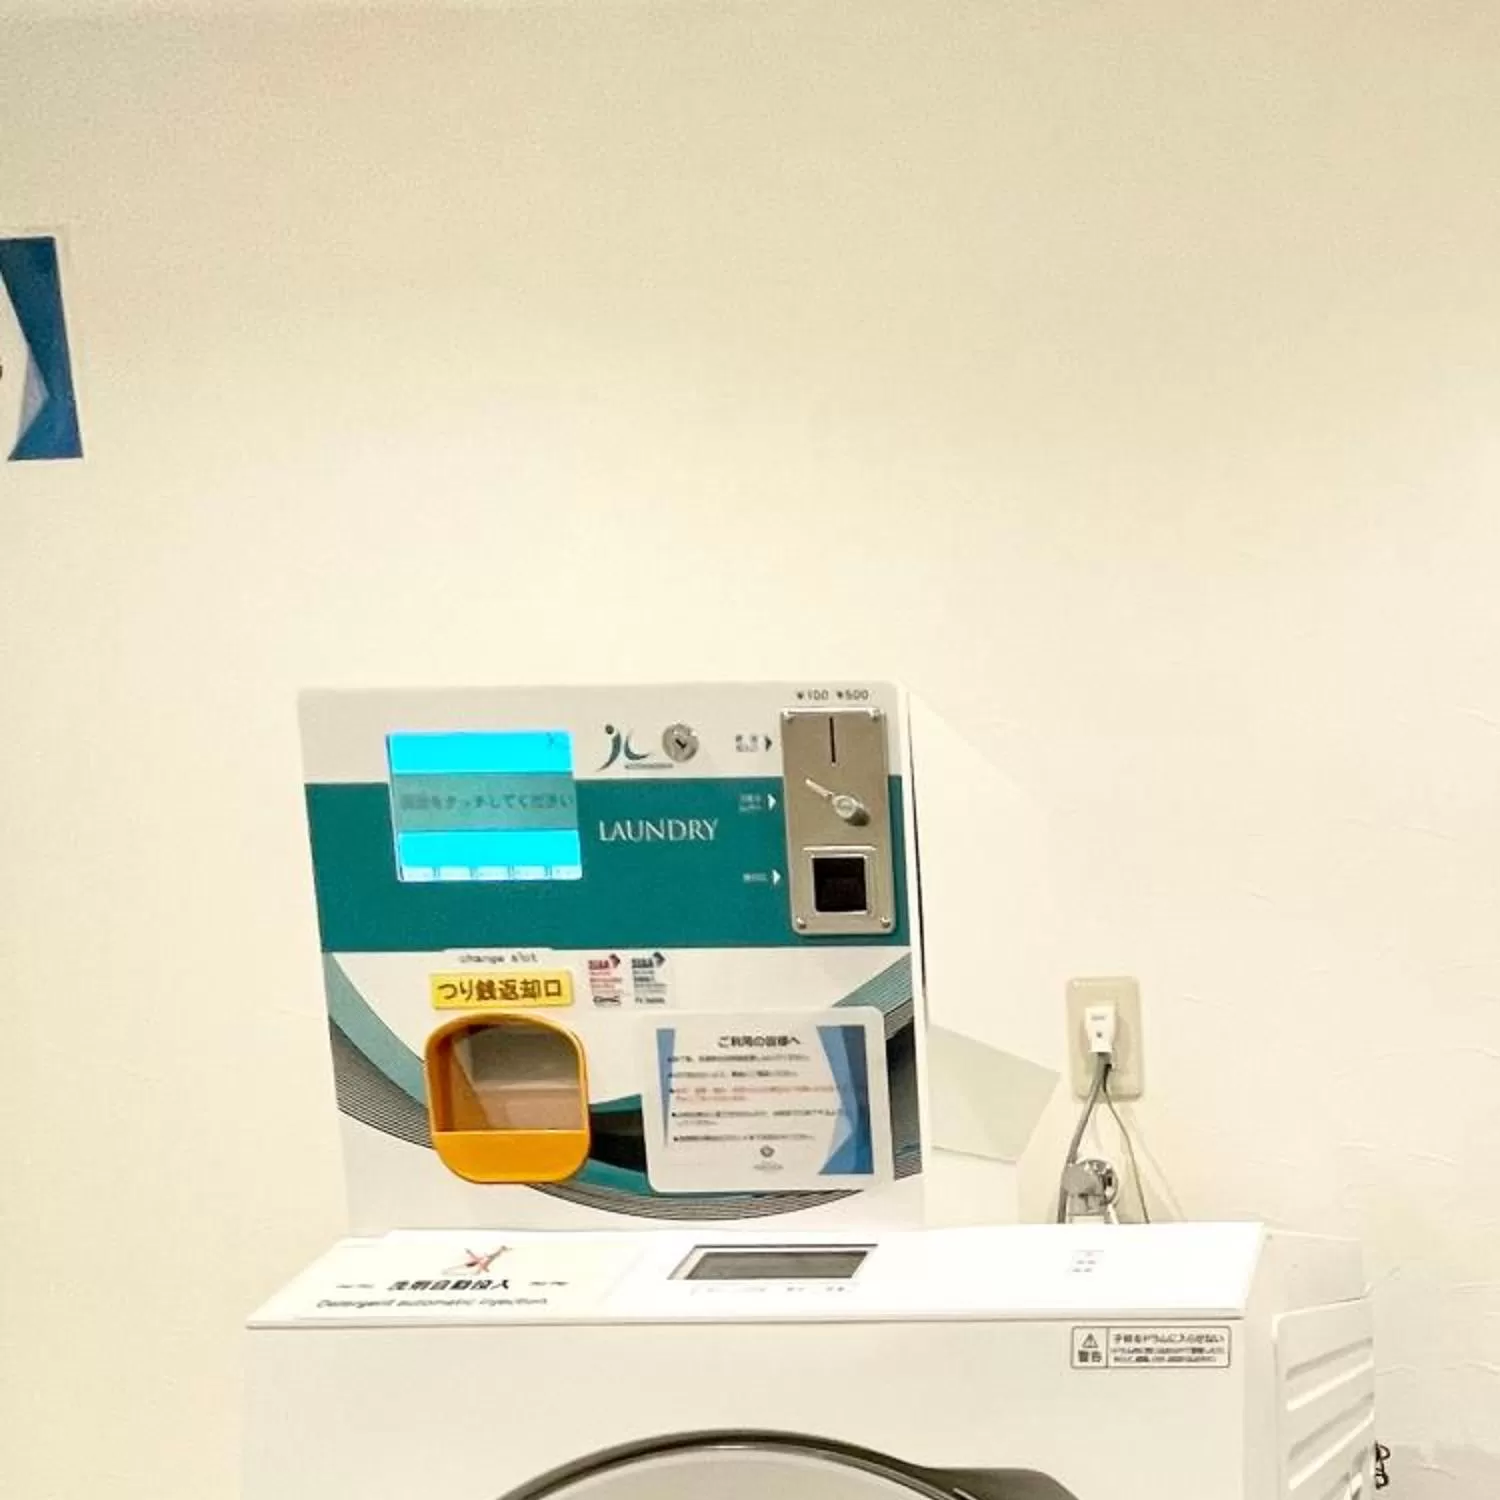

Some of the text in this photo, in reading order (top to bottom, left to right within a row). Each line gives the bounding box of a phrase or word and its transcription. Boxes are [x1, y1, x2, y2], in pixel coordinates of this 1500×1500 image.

[598, 818, 719, 843] LAUNDRY
[458, 953, 505, 965] change
[438, 978, 562, 1001] つり銭返却口
[387, 1279, 510, 1291] 洗剤自動投入
[316, 1299, 395, 1309] Detergent
